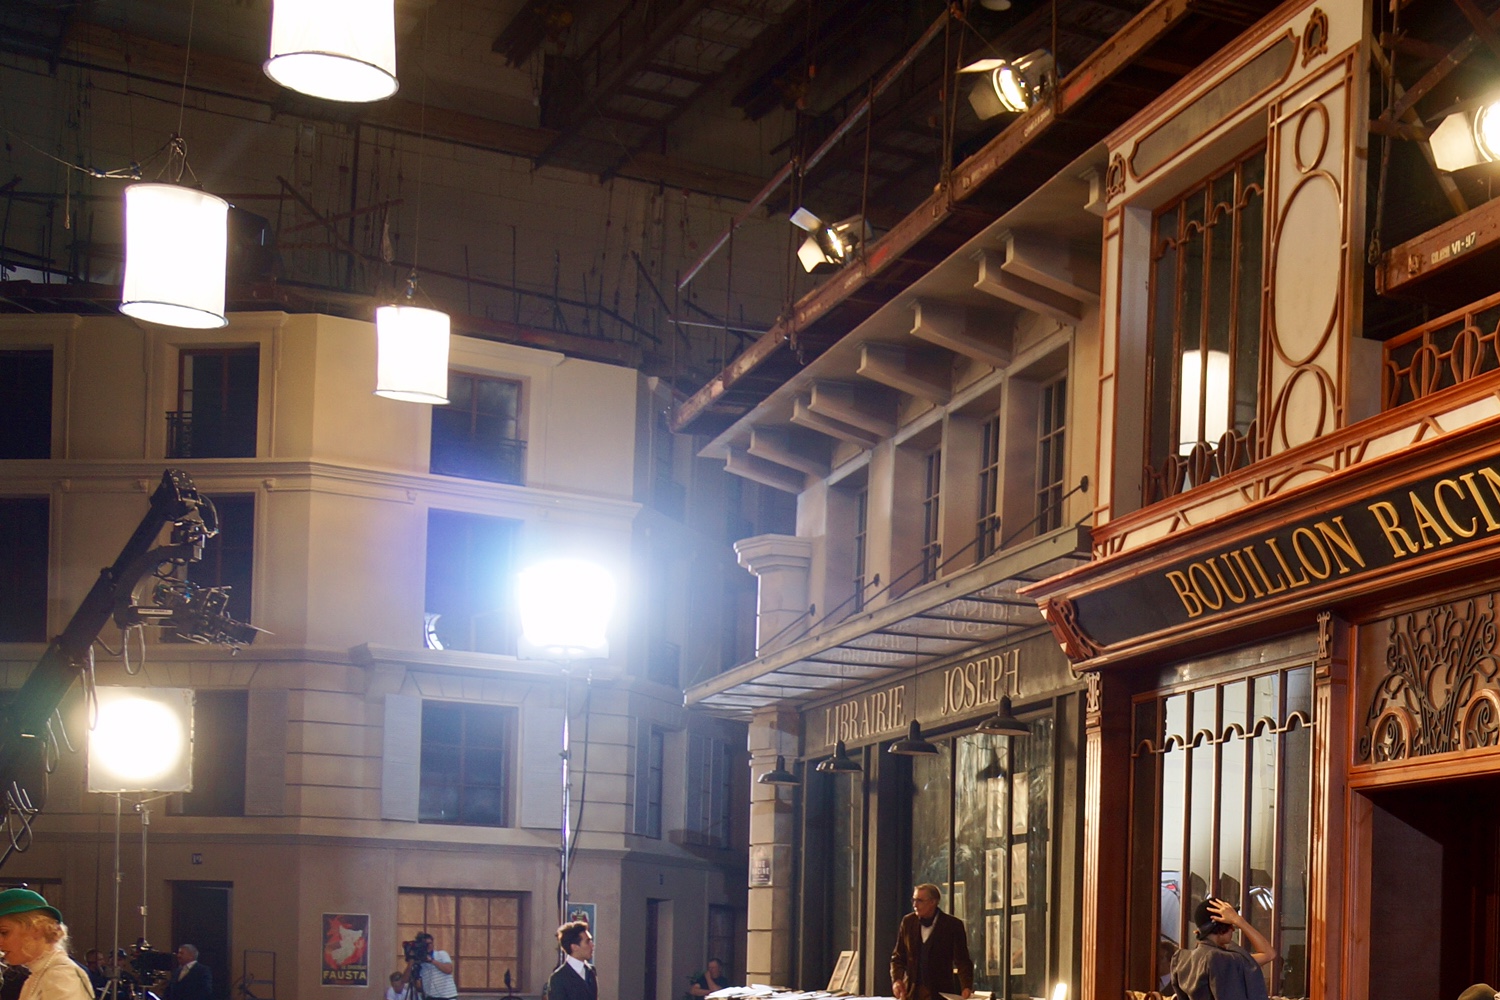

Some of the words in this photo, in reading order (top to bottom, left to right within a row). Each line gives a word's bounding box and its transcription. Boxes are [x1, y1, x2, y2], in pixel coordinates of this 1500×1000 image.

[1165, 515, 1366, 618] BOUILLON
[826, 684, 906, 746] LIBRAIRIE
[940, 649, 1024, 716] JOSEPH
[323, 970, 367, 980] FAUSTA
